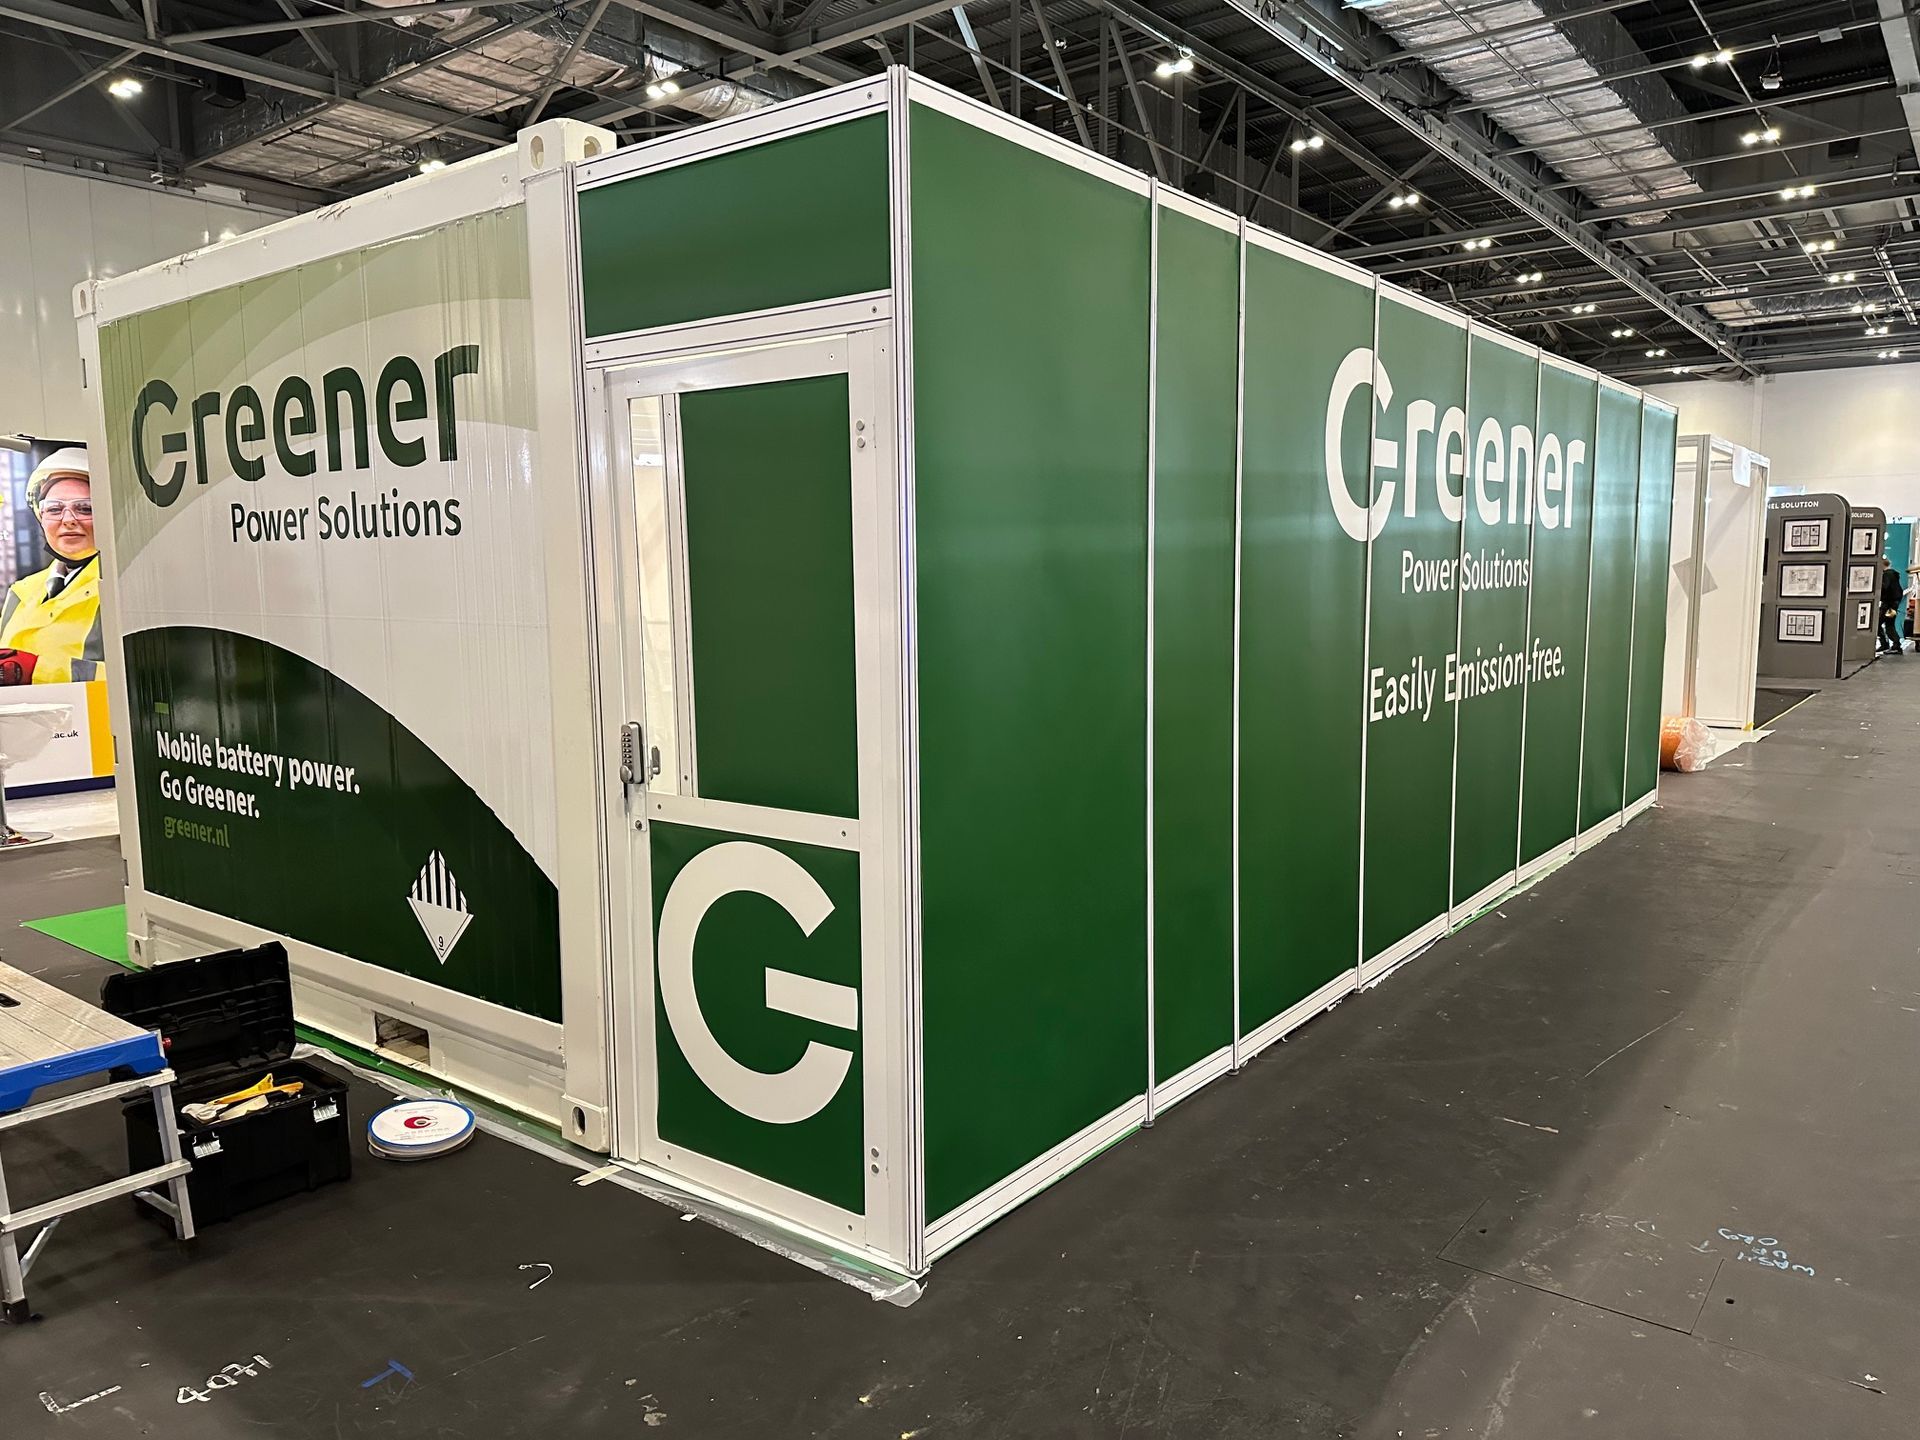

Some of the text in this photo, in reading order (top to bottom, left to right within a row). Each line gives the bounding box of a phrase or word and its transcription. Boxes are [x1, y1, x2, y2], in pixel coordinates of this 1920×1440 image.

[131, 344, 480, 508] Greener
[1325, 347, 1586, 543] Greener
[230, 488, 462, 543] Power Solutions
[1780, 500, 1819, 509] SOLUTION
[1401, 548, 1529, 594] Power Solutions
[1369, 637, 1566, 723] Easily Emission-free.
[53, 730, 79, 739] .ac.uk
[215, 737, 284, 788] battery
[288, 757, 361, 795] power.
[160, 770, 260, 819] Go Greener.
[163, 816, 231, 849] greener.nl
[657, 840, 859, 1125] G
